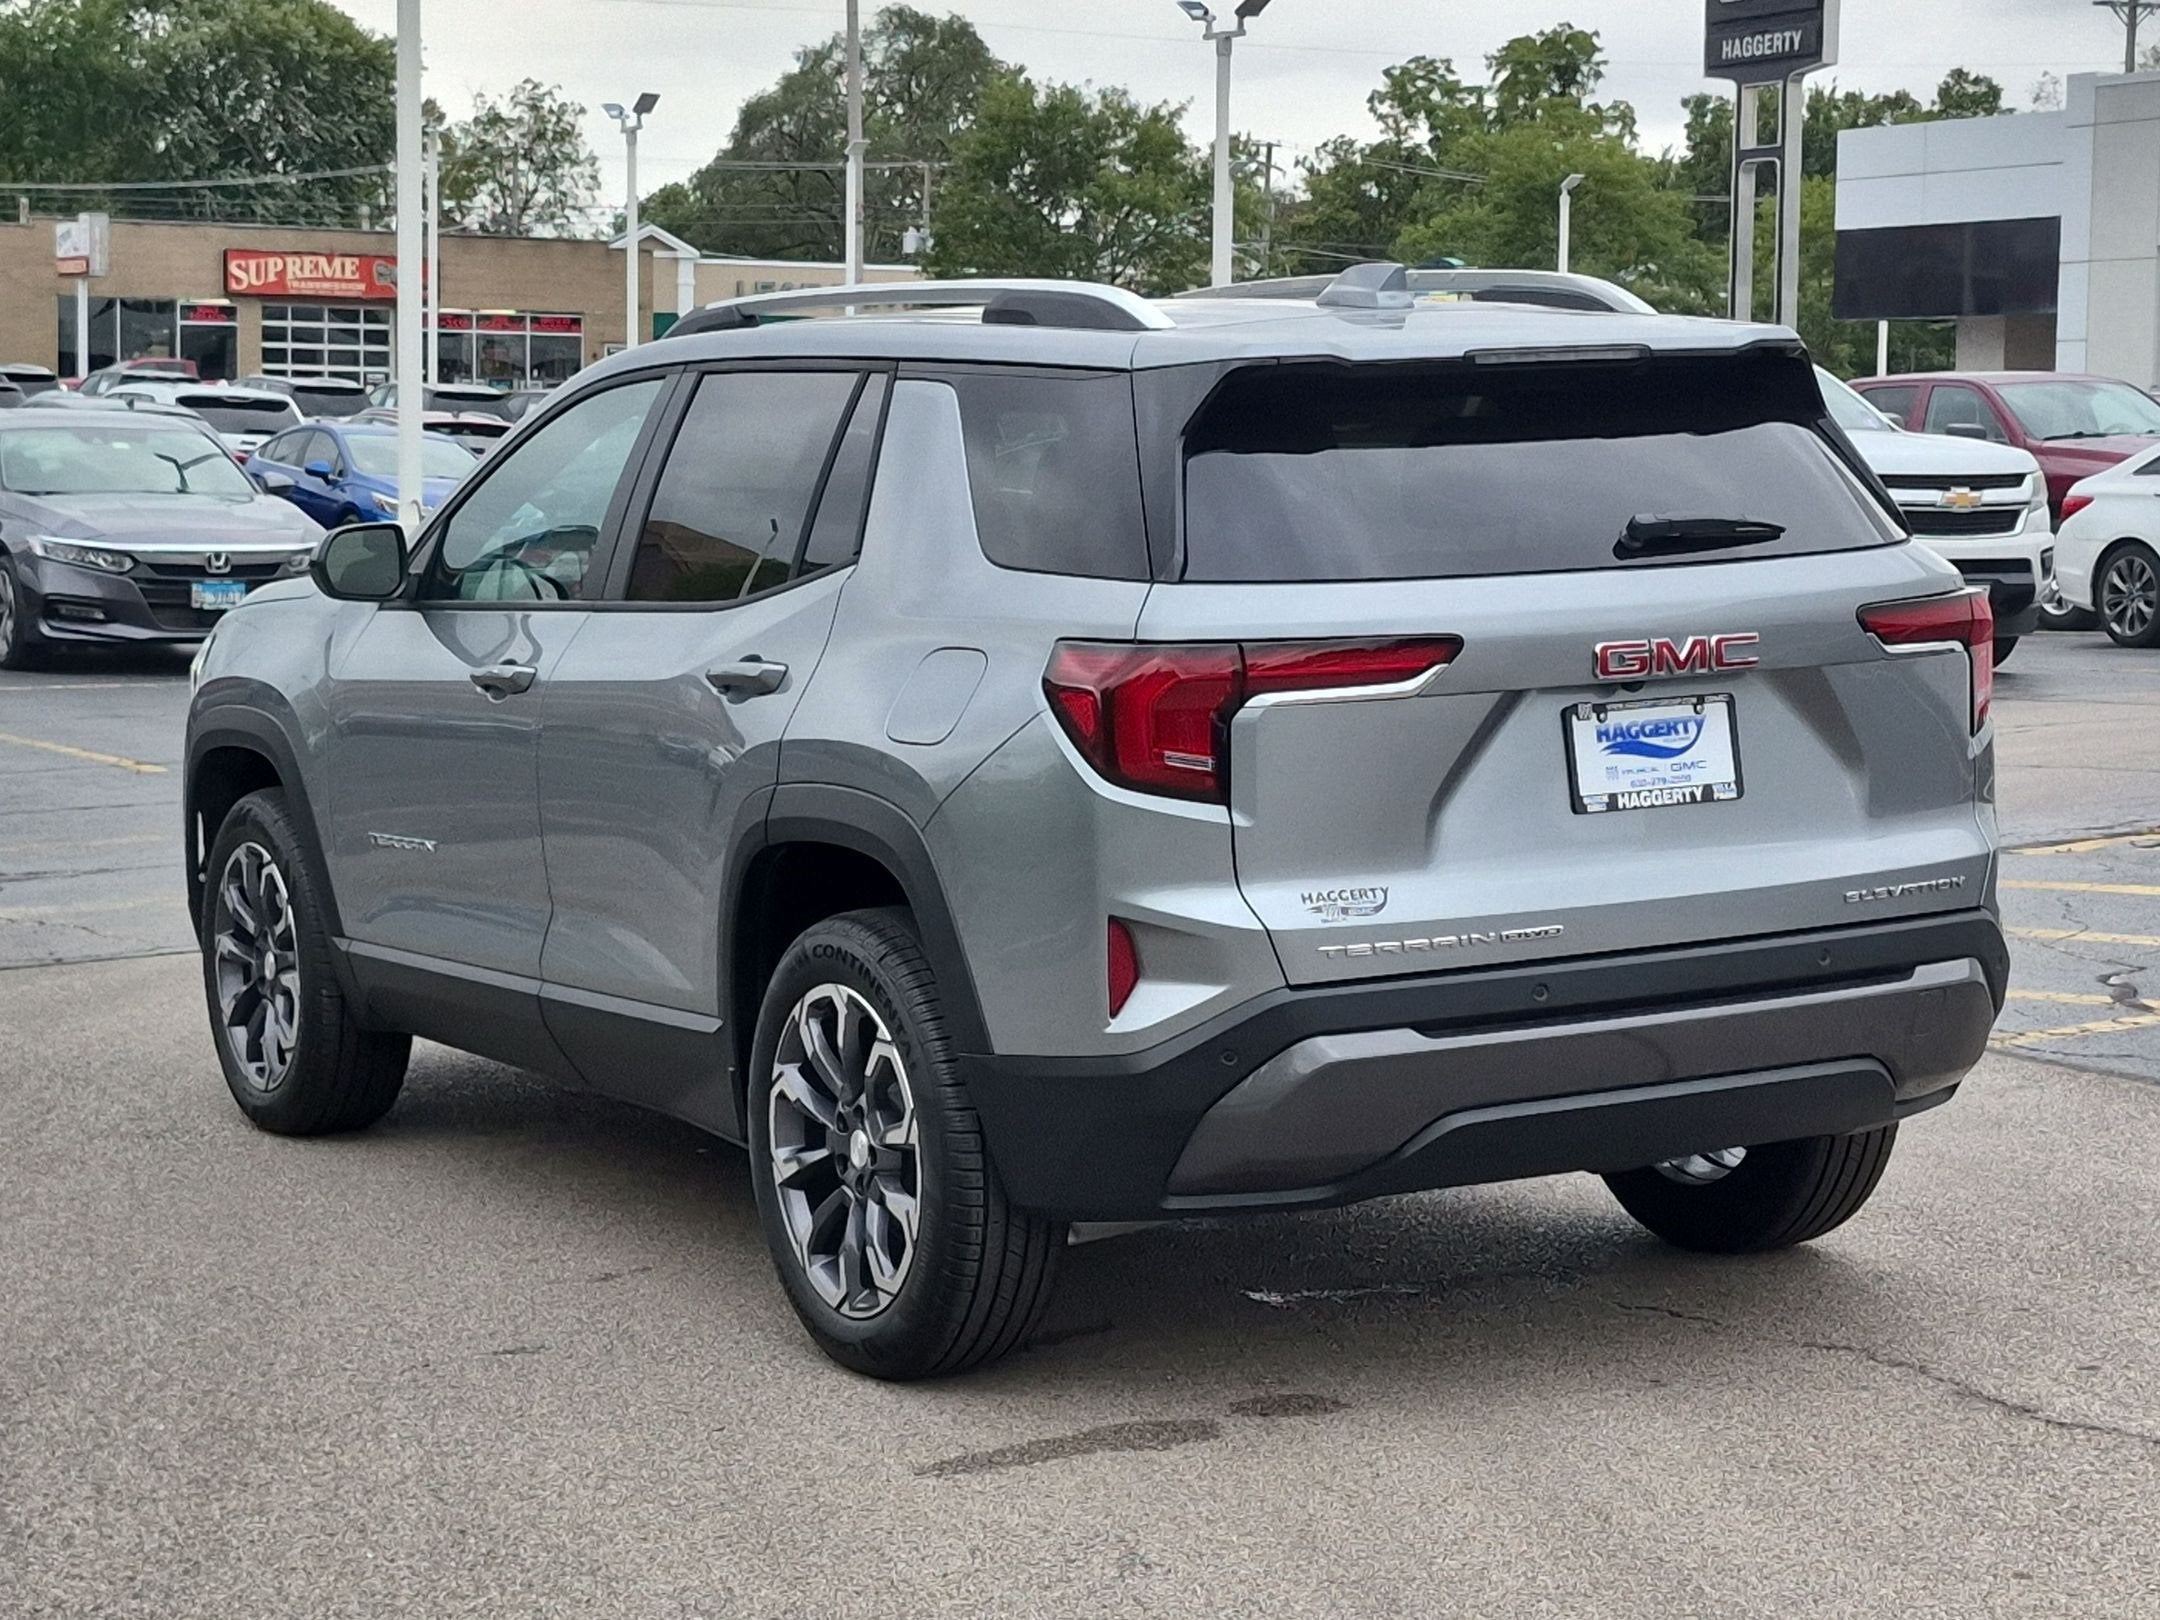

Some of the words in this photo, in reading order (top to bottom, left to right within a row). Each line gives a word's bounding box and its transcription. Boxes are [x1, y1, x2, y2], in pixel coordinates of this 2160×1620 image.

[1721, 30, 1802, 59] HAGGERTY
[229, 255, 360, 290] SUPREME
[1594, 632, 1759, 680] GMC
[1595, 715, 1706, 743] HAGGERTY
[1670, 760, 1707, 772] GMC
[1617, 785, 1704, 810] HAGGERTY
[1300, 886, 1389, 905] HAGGERTY
[1844, 875, 1966, 903] ELEVATION
[1317, 933, 1495, 959] TERRAIN
